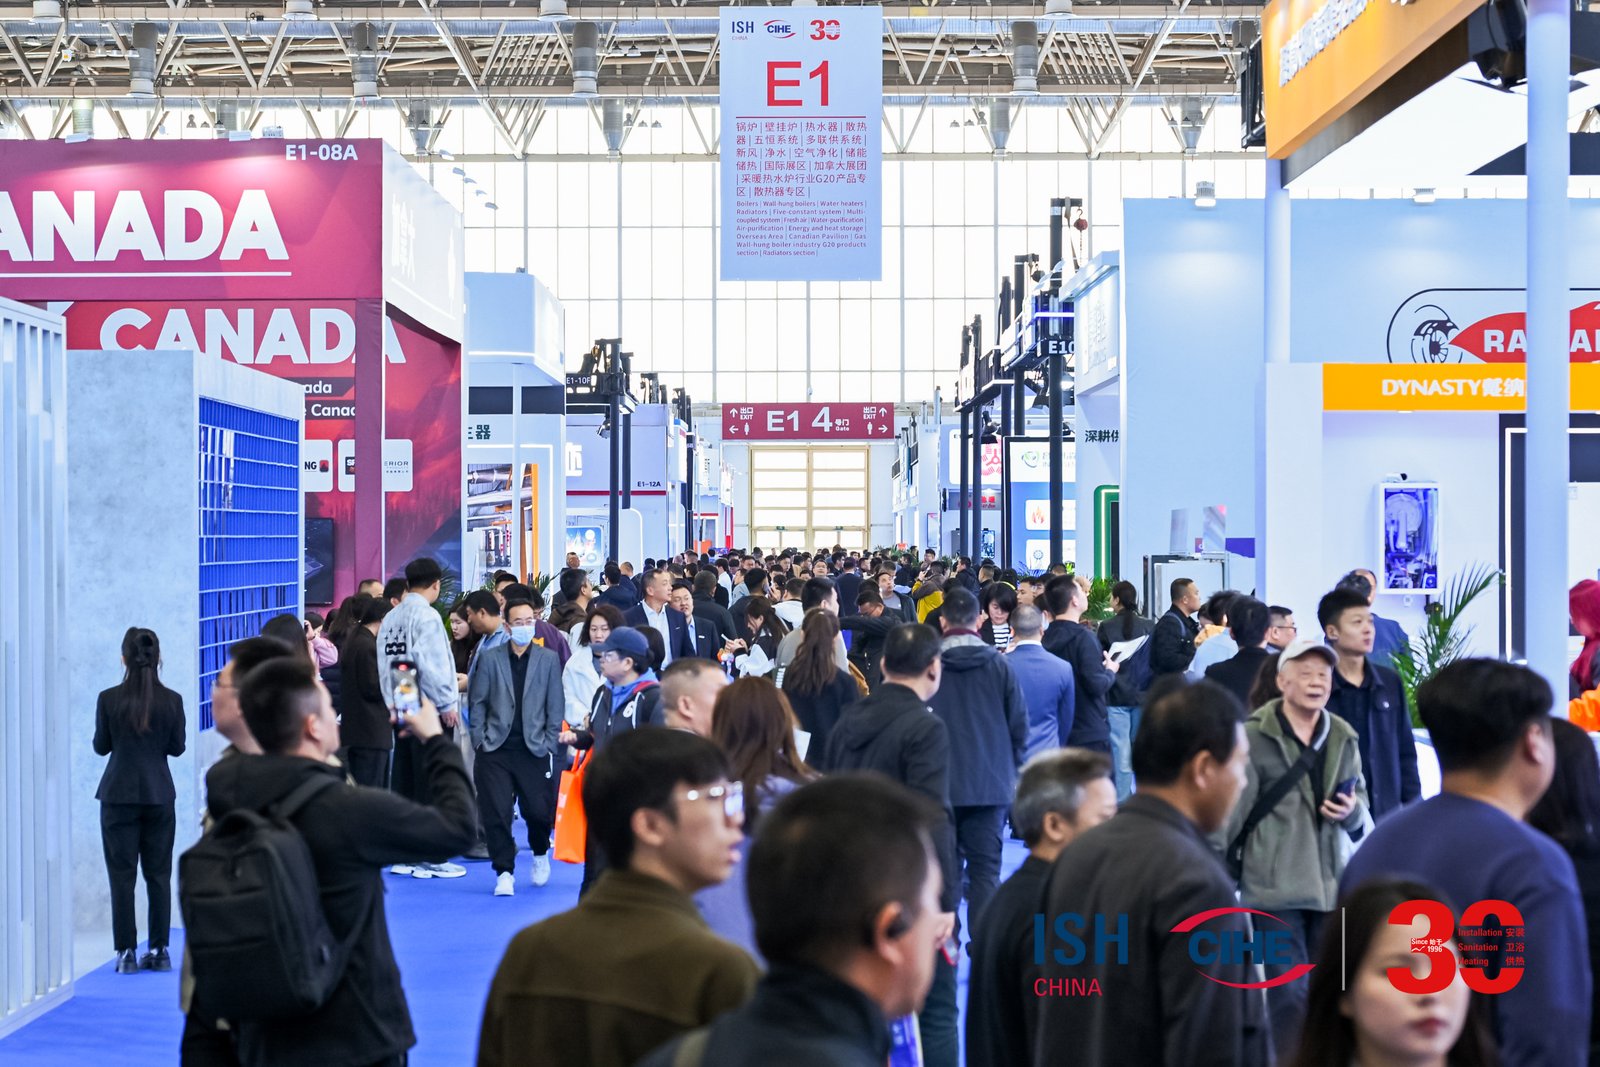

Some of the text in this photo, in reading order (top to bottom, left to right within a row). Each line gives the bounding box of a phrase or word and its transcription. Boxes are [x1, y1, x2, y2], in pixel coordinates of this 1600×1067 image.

[731, 21, 755, 34] ISH
[767, 25, 792, 34] CIHE
[810, 19, 840, 41] 30
[767, 60, 829, 107] E1
[805, 121, 838, 132] 热水器
[845, 121, 867, 132] 散热
[754, 134, 798, 145] 五恒系统
[806, 134, 862, 145] 多联供系统
[285, 144, 358, 161] E1-08A
[736, 148, 867, 158] 新风 净水 空气净化 储能
[764, 160, 806, 171] 国际展区
[754, 186, 805, 197] 散热器专区
[566, 377, 591, 385] E1-10F
[766, 406, 833, 433] E1 4
[637, 480, 662, 488] E1-12A
